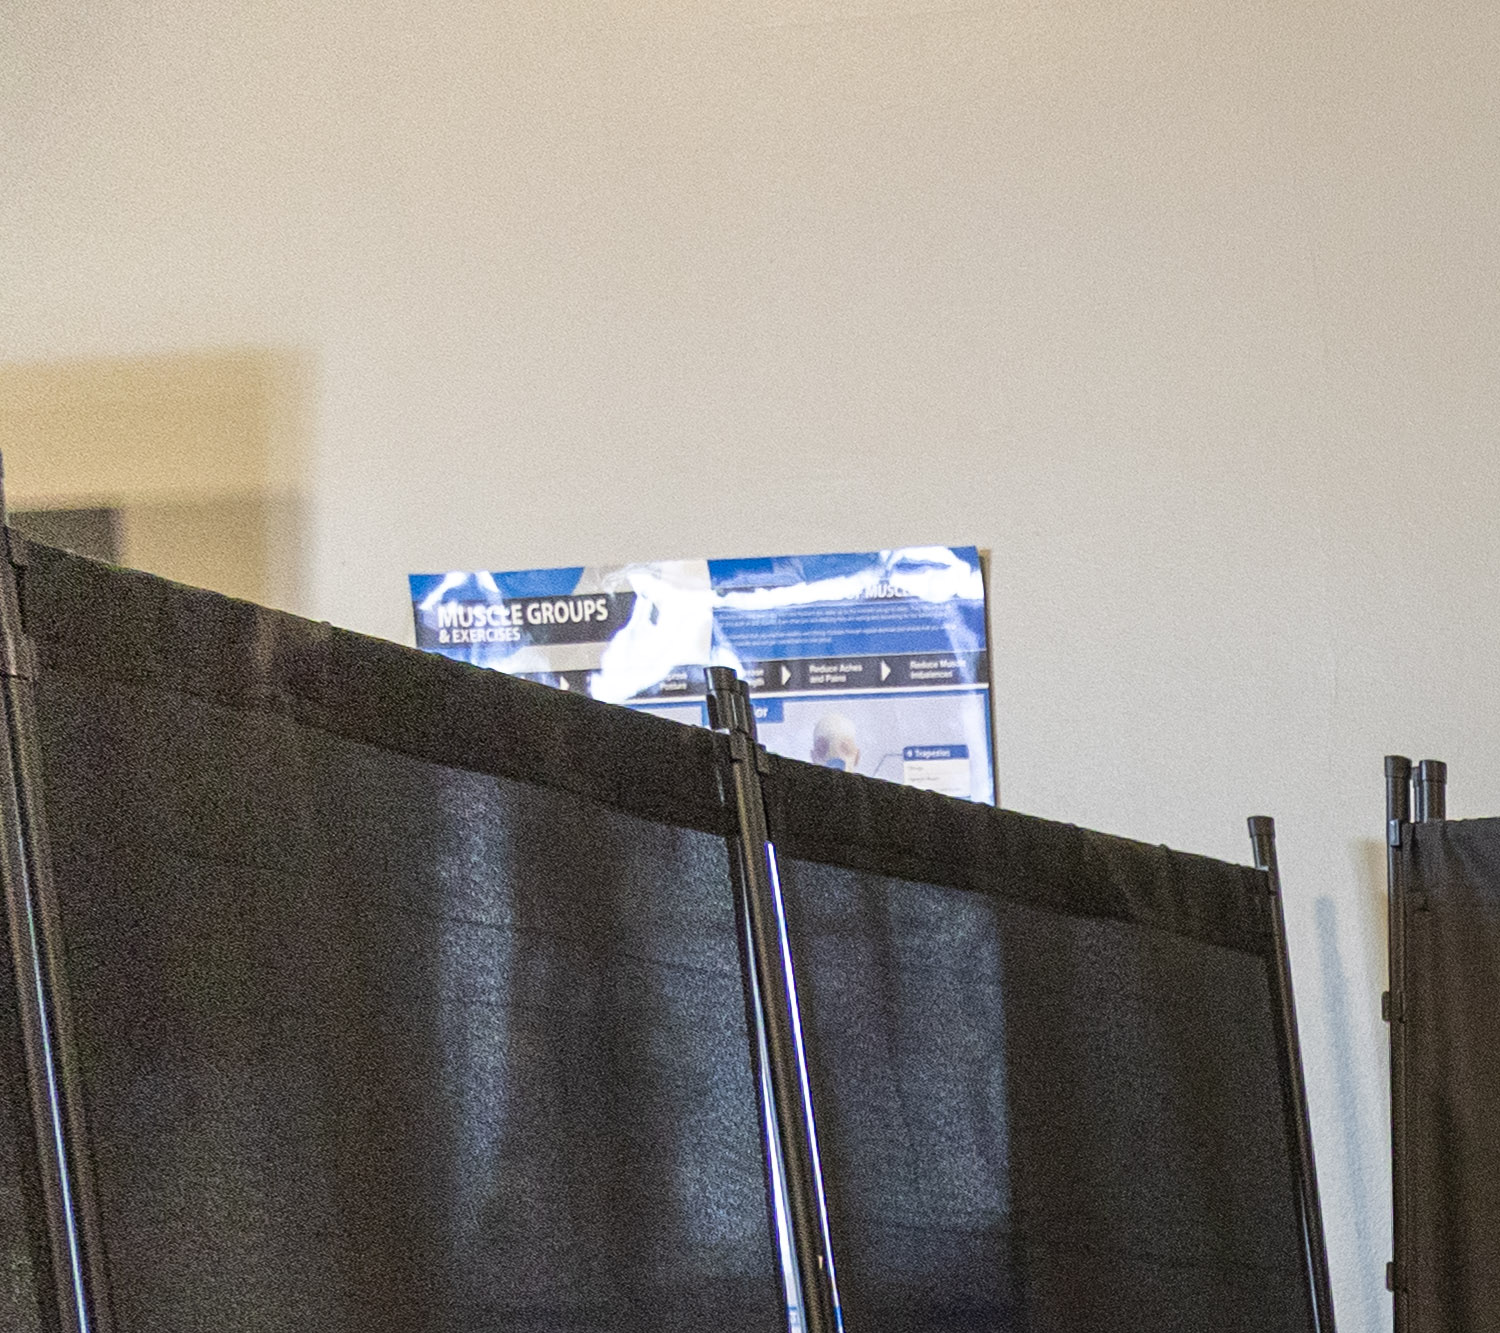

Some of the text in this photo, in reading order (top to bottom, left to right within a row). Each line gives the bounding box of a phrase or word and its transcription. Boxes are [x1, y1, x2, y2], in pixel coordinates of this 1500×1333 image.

[438, 599, 609, 628] MUSCLE GROUPS
[439, 628, 521, 643] & EXERCISES
[810, 664, 838, 674] Reduce
